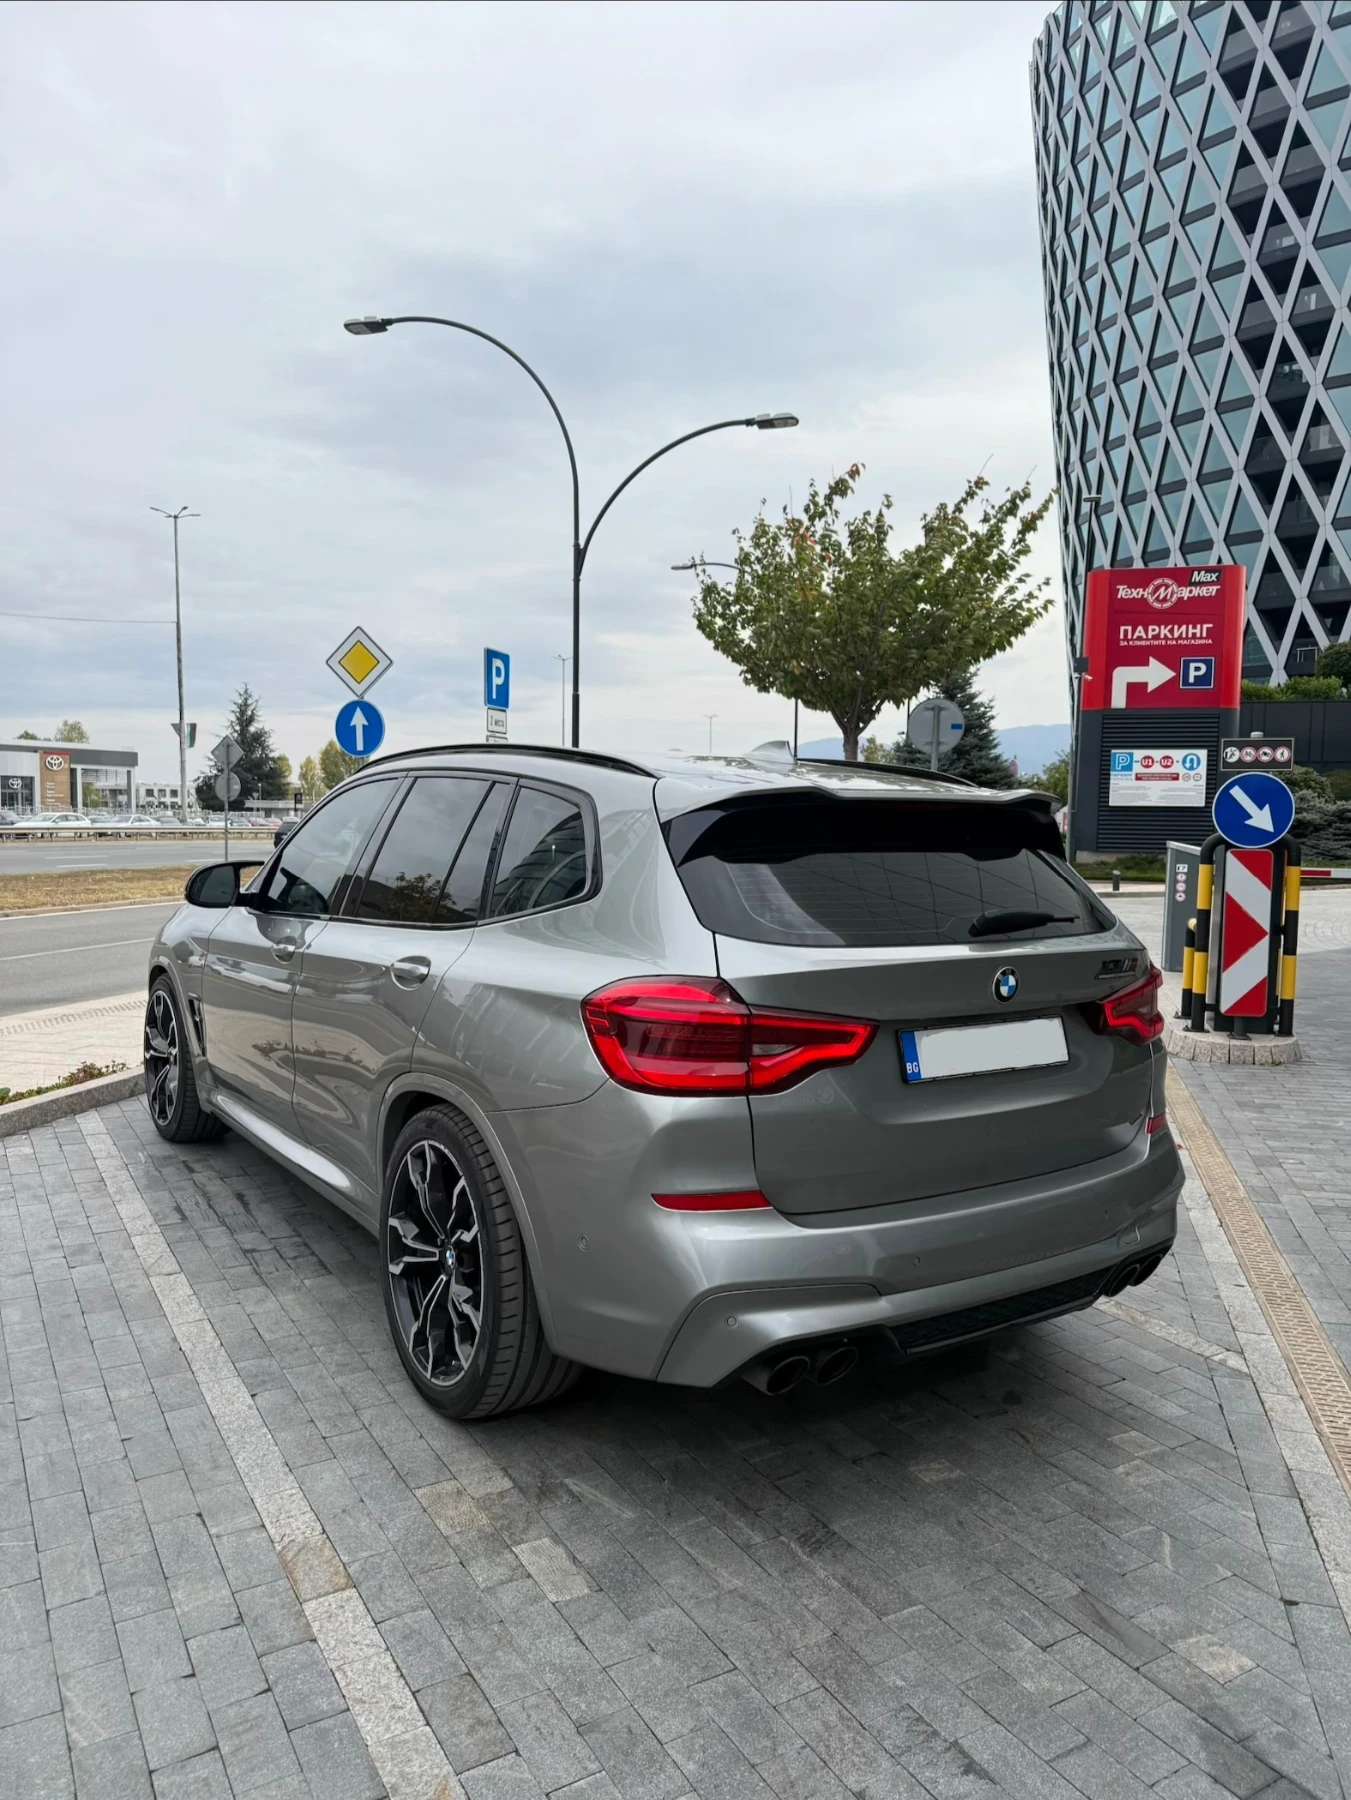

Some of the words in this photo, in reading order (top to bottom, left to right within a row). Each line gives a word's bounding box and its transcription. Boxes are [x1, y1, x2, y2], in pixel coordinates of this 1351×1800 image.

[1191, 570, 1219, 583] Max
[1119, 624, 1213, 639] ПАРКИНГ
[492, 657, 506, 699] P
[1188, 662, 1207, 684] P
[1142, 758, 1153, 766] U1
[1161, 758, 1173, 766] U2
[905, 1061, 919, 1074] BG
